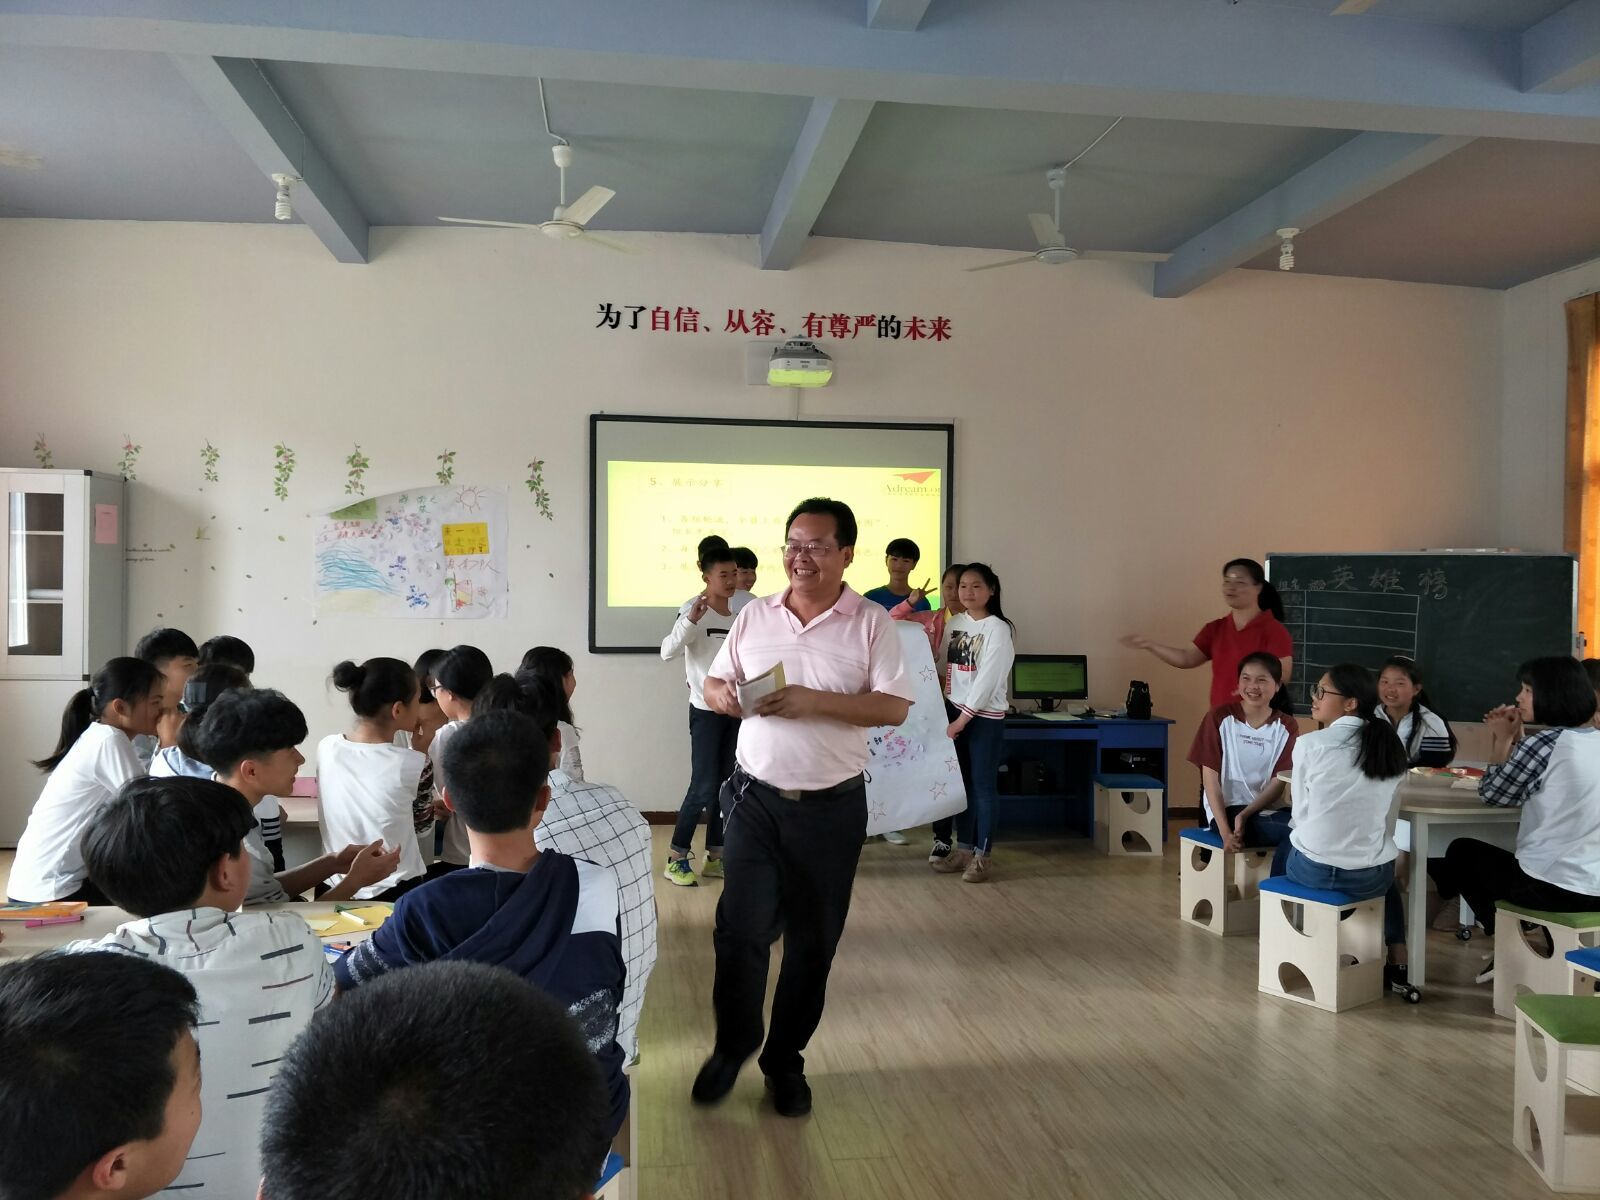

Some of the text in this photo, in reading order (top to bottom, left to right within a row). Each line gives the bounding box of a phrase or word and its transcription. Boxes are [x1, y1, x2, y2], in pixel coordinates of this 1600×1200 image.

[596, 303, 952, 341] 为了自信、从容、有尊严的未来
